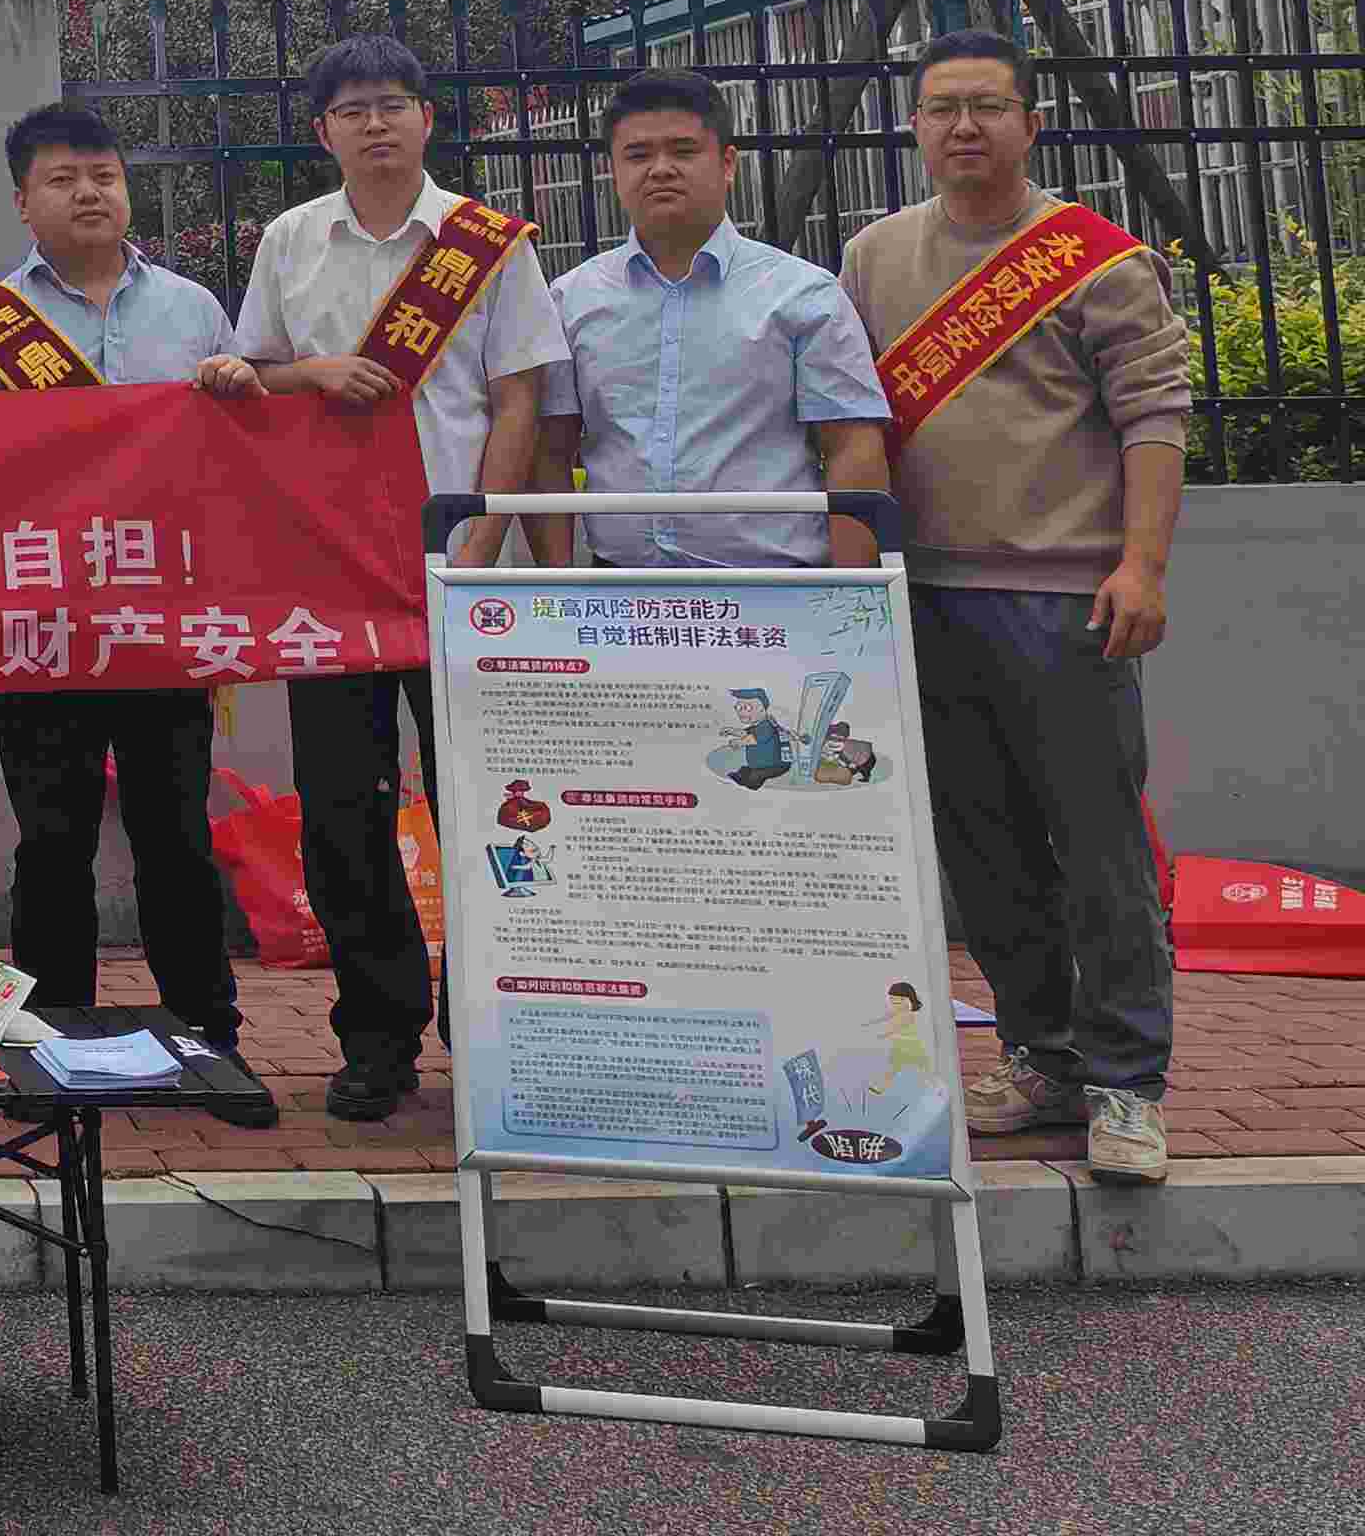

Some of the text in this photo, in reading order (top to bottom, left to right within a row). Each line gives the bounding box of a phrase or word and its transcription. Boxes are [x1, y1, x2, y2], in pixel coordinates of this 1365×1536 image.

[532, 596, 742, 621] 提高风险防范能力
[575, 625, 788, 649] 自觉抵制非法集资
[826, 1133, 886, 1161] 陷阱
